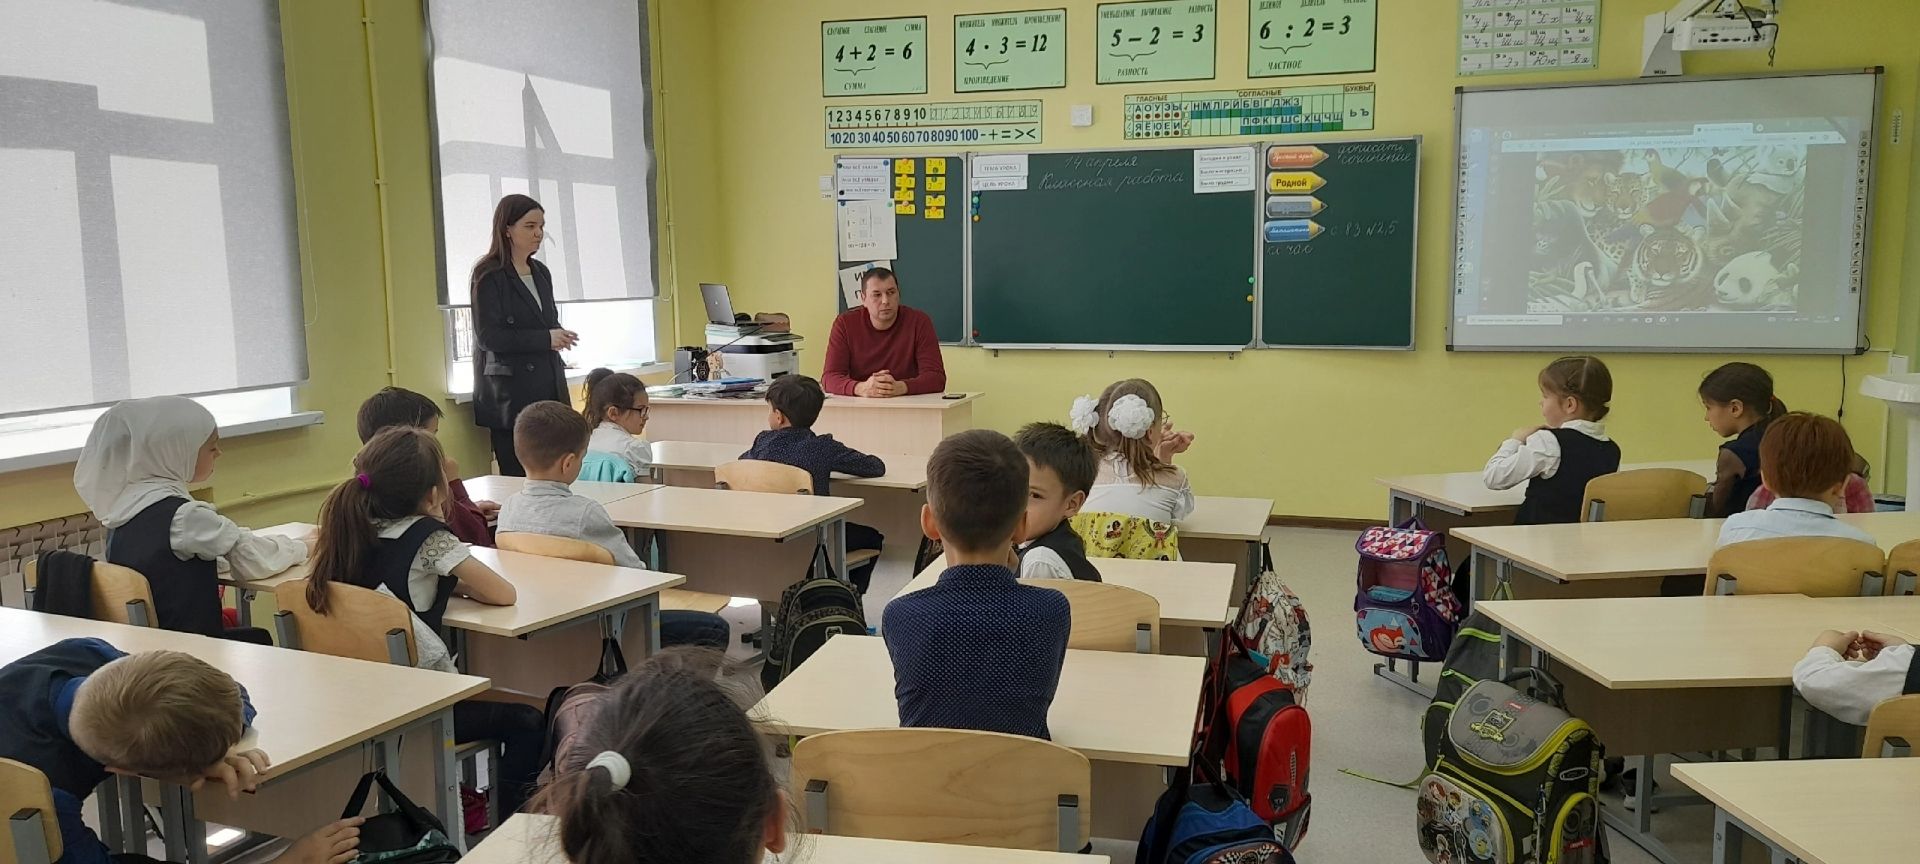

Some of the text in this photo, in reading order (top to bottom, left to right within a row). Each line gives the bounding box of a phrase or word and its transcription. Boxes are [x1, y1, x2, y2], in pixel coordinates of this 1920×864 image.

[1189, 4, 1213, 14] РАЗНОСТЬ
[1260, 21, 1271, 39] 6
[1303, 18, 1315, 37] 2
[1339, 15, 1351, 35] 3
[1111, 29, 1122, 46] 5
[1149, 27, 1160, 45] 2
[1192, 24, 1204, 42] 3
[966, 38, 975, 56] 4
[1000, 36, 1008, 54] 3
[1031, 34, 1047, 52] 12
[835, 45, 845, 62] 4
[867, 44, 876, 61] 2
[903, 42, 913, 59] 6
[1268, 60, 1302, 70] ЧАСТНОЕ
[1118, 68, 1148, 76] РАЗНОСТЬ
[964, 75, 1009, 85] ПРОИЗВЕДЕНИЕ
[844, 82, 866, 90] СУММА
[1233, 100, 1239, 108] Й
[1272, 98, 1280, 106] Д
[828, 108, 926, 122] 1 2 3 4 5 6 7 8 9 10
[1350, 109, 1357, 117] Ь
[1281, 116, 1291, 124] Ш
[1293, 115, 1299, 123] С
[1304, 114, 1310, 122] Х
[1314, 114, 1320, 122] Ц
[1334, 113, 1343, 122] Щ
[1146, 122, 1151, 130] Ё
[831, 129, 978, 144] 10 20 30 40 50 60 70 80 90 100
[1065, 156, 1138, 176] 14 апреля
[1039, 169, 1184, 192] Классная работа
[1276, 178, 1307, 188] Родной
